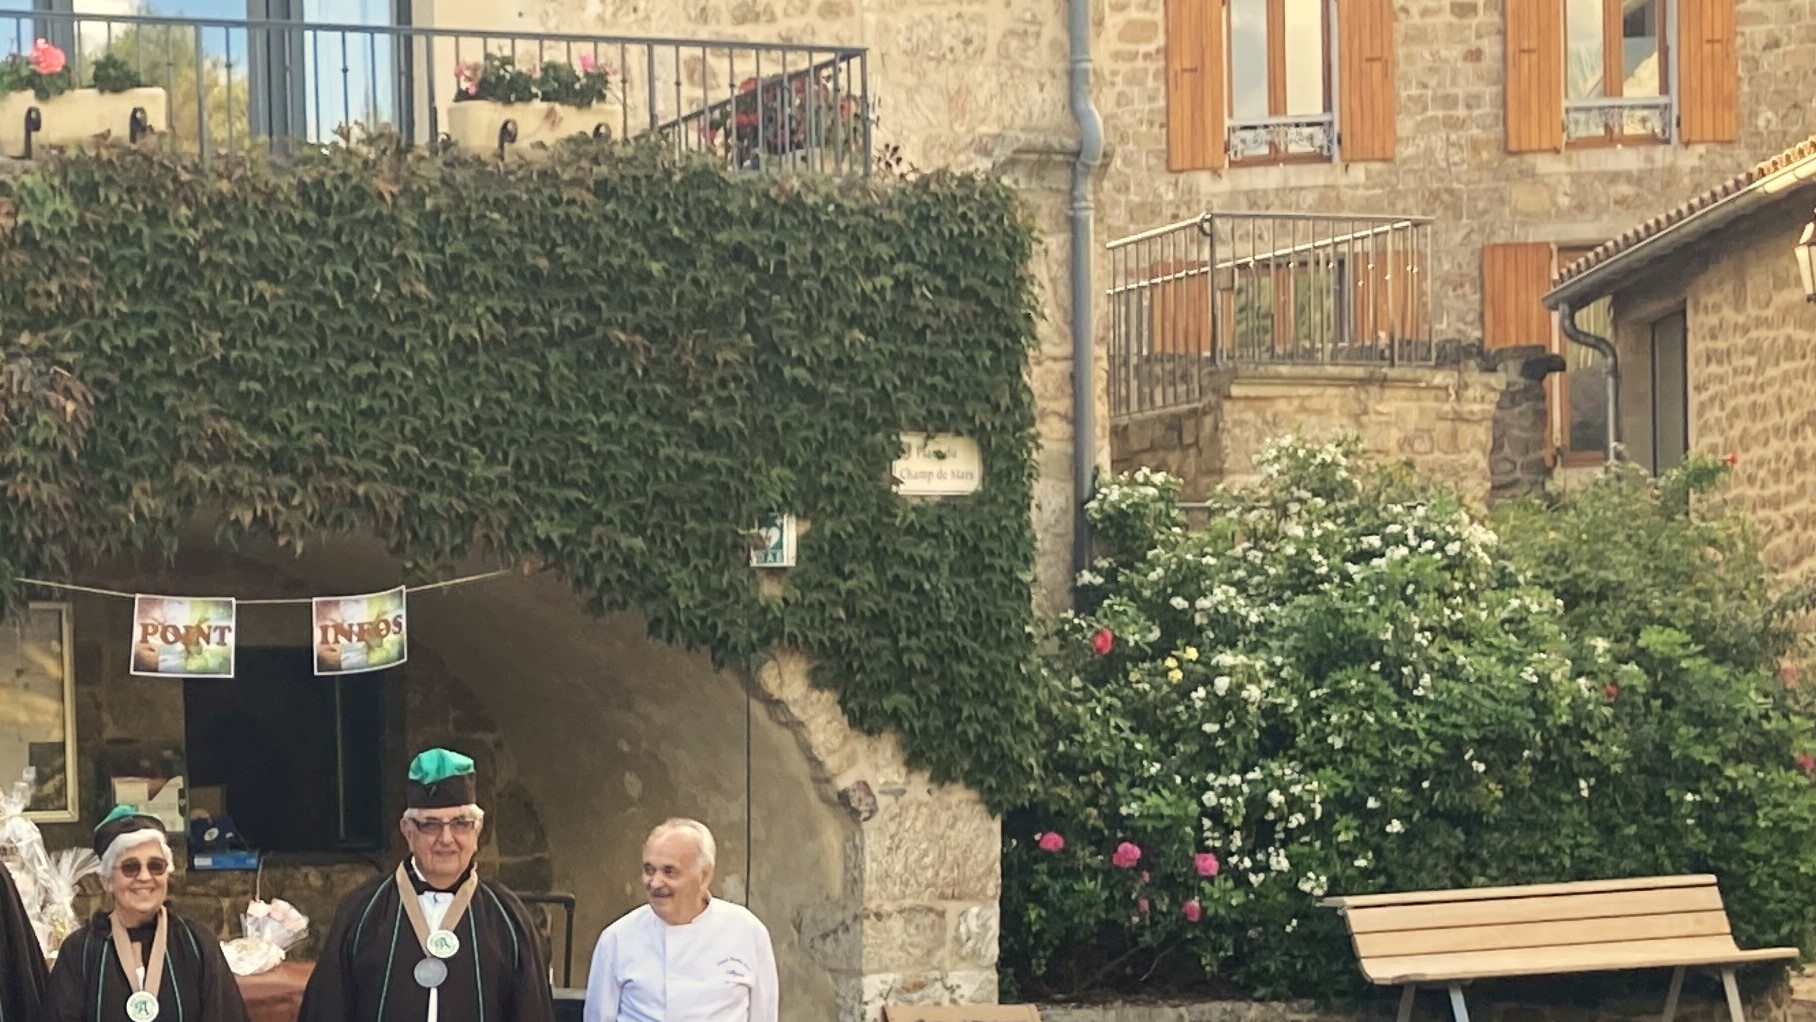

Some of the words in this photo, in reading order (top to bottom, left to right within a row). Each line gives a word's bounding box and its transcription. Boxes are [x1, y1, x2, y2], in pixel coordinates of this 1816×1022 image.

[900, 468, 934, 484] Champ
[937, 468, 948, 479] de
[950, 469, 974, 480] Mars
[139, 621, 232, 647] POINT
[319, 614, 403, 646] INFOS
